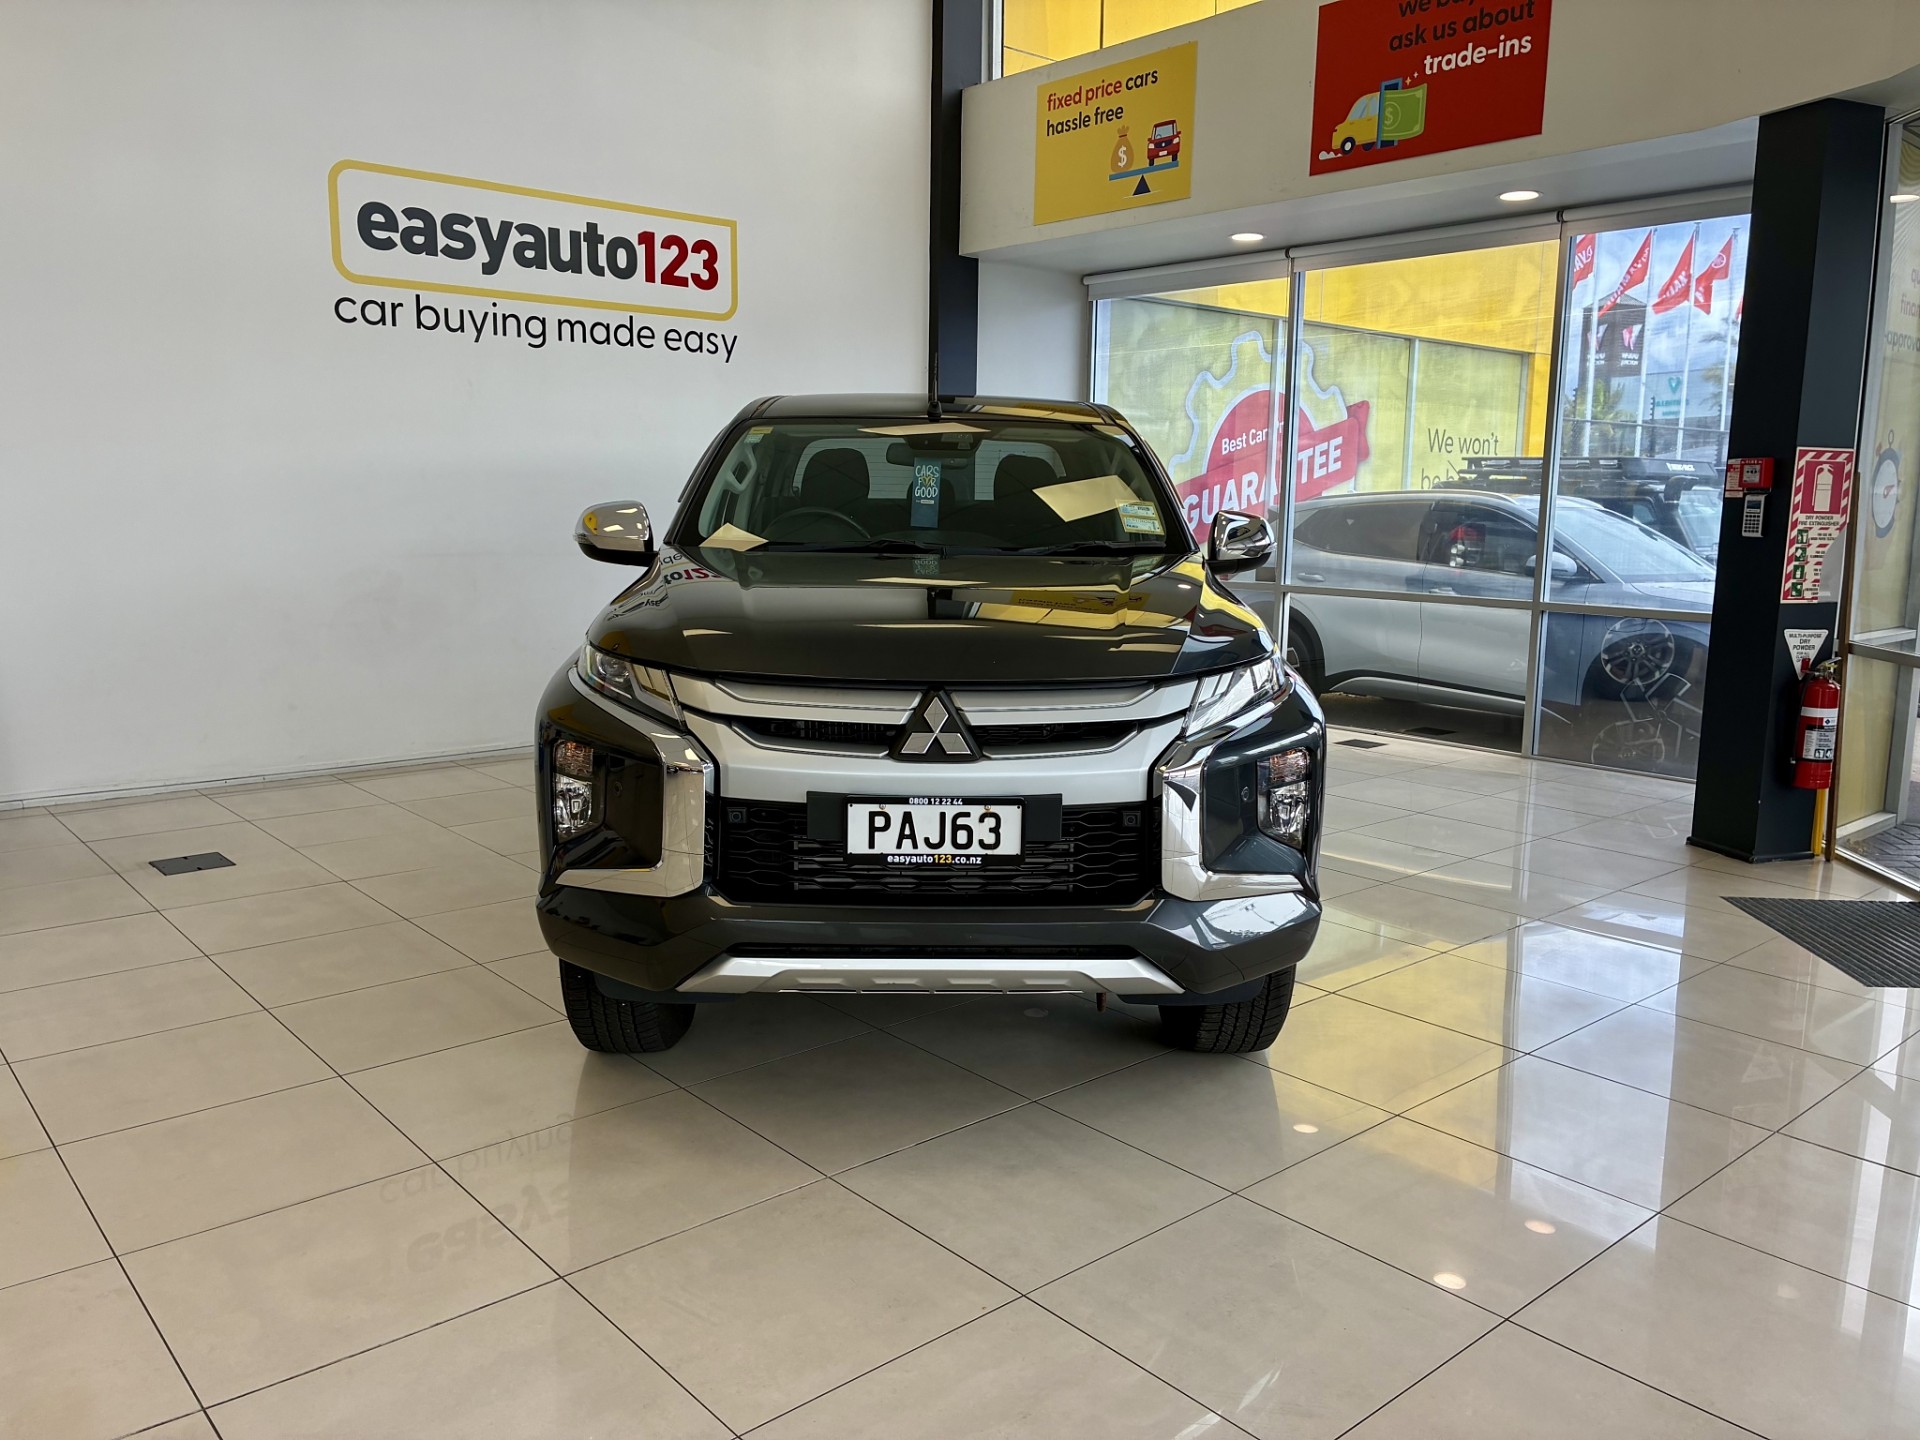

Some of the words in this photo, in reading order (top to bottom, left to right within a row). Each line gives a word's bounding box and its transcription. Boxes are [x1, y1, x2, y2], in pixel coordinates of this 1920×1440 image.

[1389, 24, 1427, 51] ask
[1432, 20, 1457, 41] us
[1462, 1, 1535, 33] about
[1424, 35, 1532, 75] trade-ins
[1047, 86, 1082, 111] fixed
[1085, 79, 1122, 106] price
[1125, 70, 1158, 91] cars
[1046, 112, 1091, 136] hassle
[1094, 106, 1124, 125] free
[357, 201, 718, 290] easyauto123
[334, 297, 403, 327] car
[415, 294, 547, 348] buying
[558, 315, 656, 348] made
[664, 328, 738, 363] easy
[1222, 435, 1247, 455] Best
[1249, 428, 1268, 446] Car
[1428, 428, 1454, 454] We
[1458, 432, 1499, 456] won't
[915, 465, 939, 478] CARS
[915, 487, 938, 498] GOOD
[868, 811, 1000, 850] PAJ63
[887, 855, 982, 865] easyauto123.co.nz
